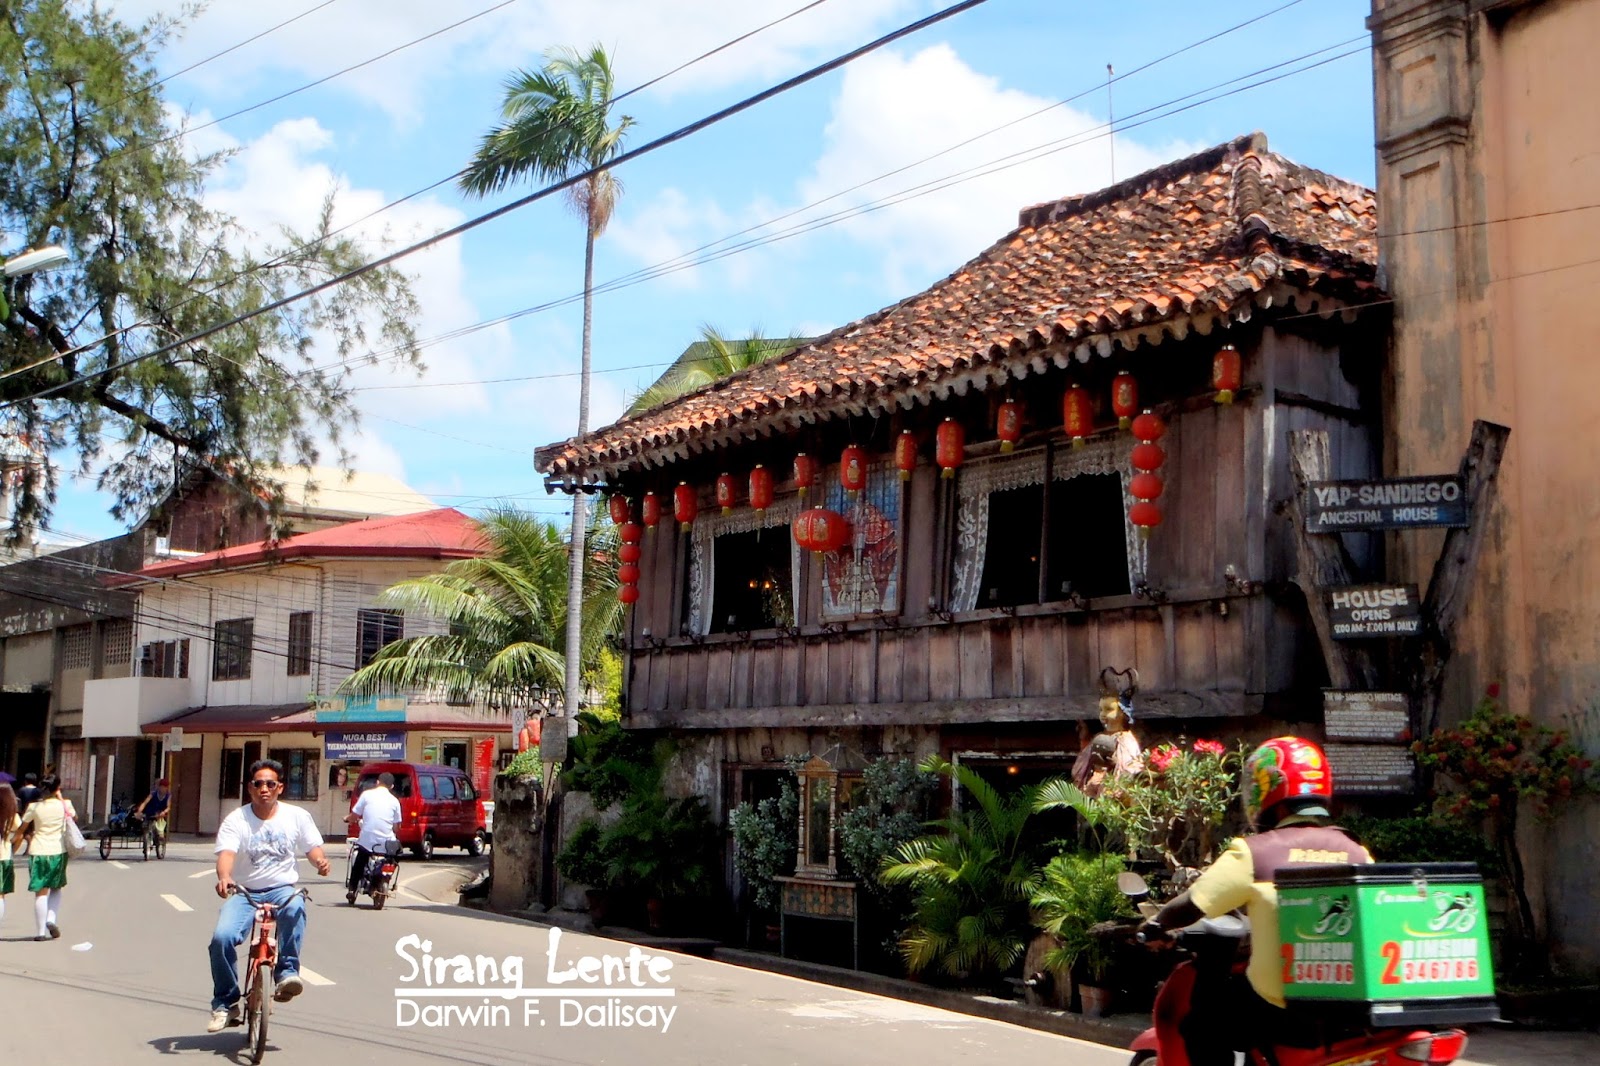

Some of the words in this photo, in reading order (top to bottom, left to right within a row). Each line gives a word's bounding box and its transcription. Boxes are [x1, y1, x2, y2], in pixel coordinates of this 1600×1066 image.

[1314, 482, 1459, 507] YAP-SANDIEGO
[1318, 510, 1383, 525] ANCESTRAL
[1393, 507, 1438, 522] HOUSE
[1332, 588, 1408, 609] HOUSE
[1351, 608, 1391, 621] OPENS
[1397, 620, 1418, 631] DAILY
[342, 733, 365, 741] NUGA
[366, 733, 387, 741] BEST
[380, 742, 402, 750] THERAPY
[1281, 943, 1294, 983] 2
[1382, 941, 1401, 984] 2
